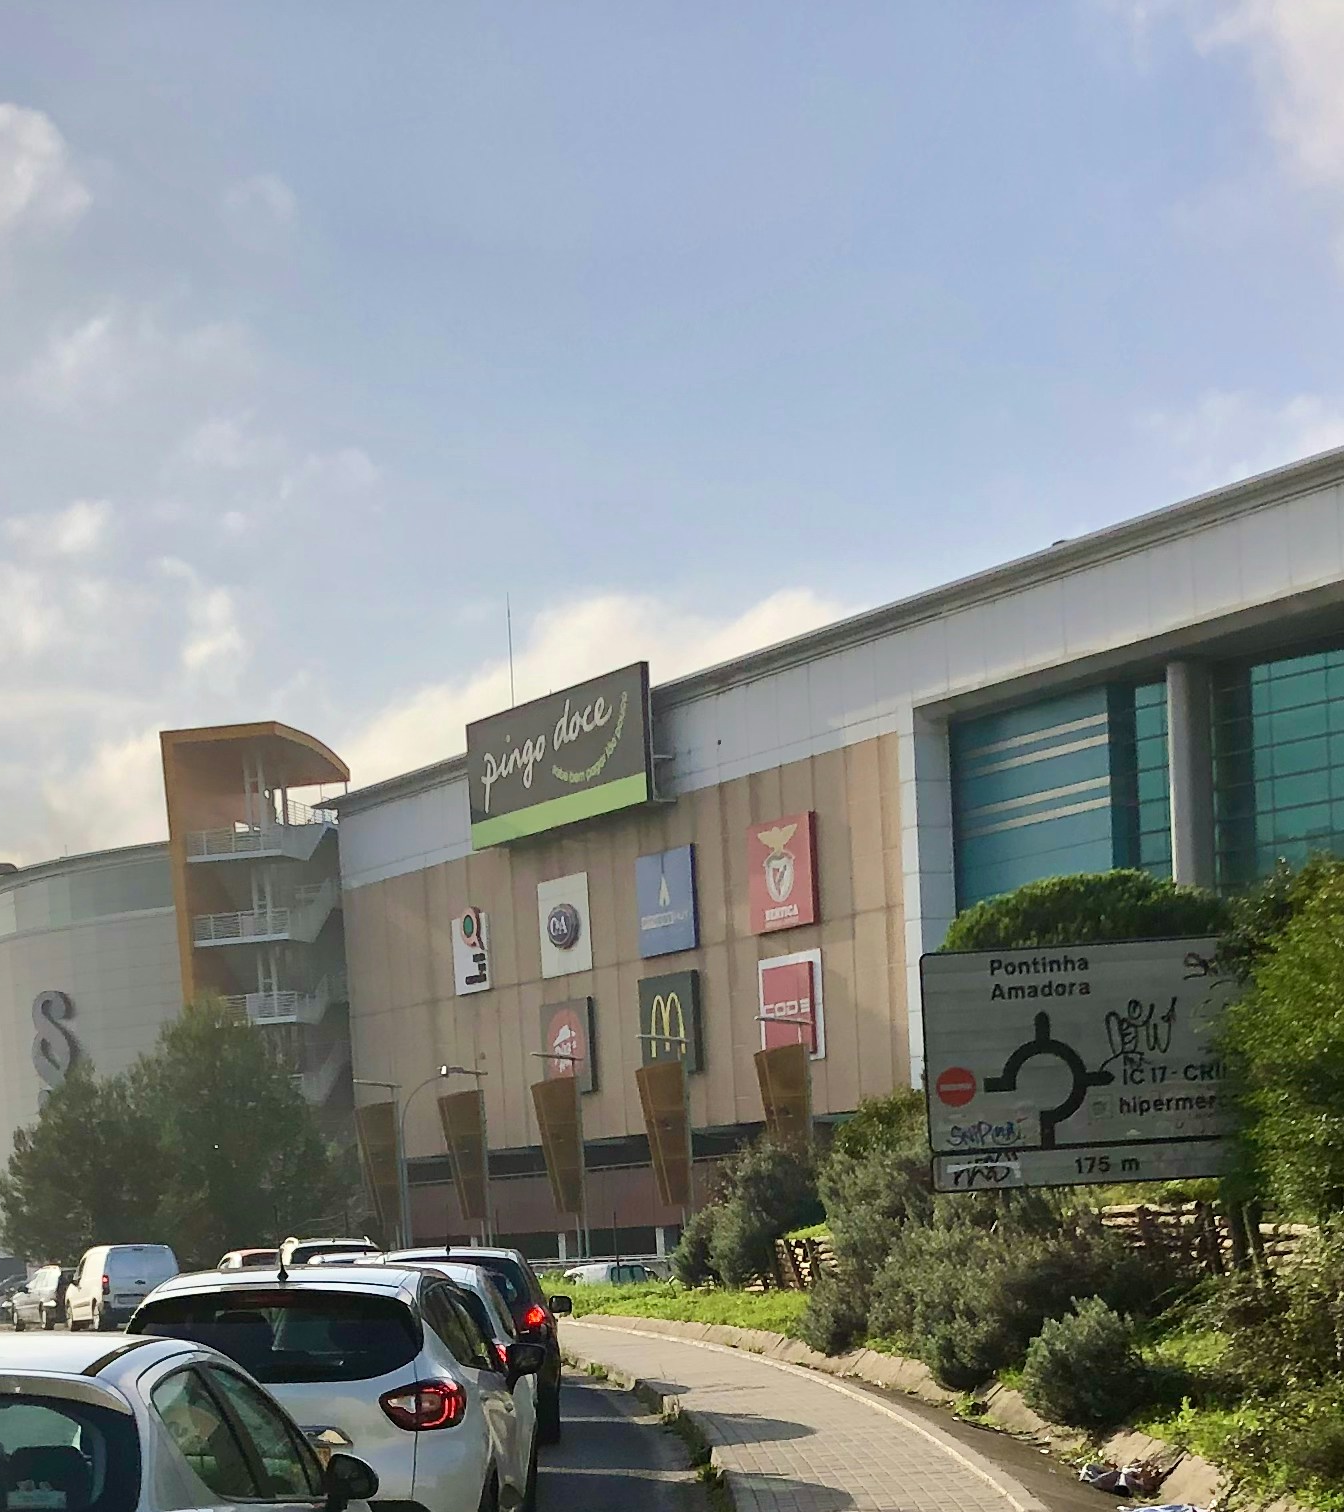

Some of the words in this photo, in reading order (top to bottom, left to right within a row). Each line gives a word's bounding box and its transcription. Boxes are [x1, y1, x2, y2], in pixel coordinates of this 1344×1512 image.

[481, 734, 546, 814] pingo
[553, 696, 613, 752] doce
[989, 955, 1089, 976] Pontinha
[991, 981, 1091, 1001] Amadora
[1123, 1067, 1145, 1085] IC
[1119, 1094, 1226, 1117] hipermer
[1074, 1156, 1111, 1174] 175
[1121, 1158, 1140, 1172] m
